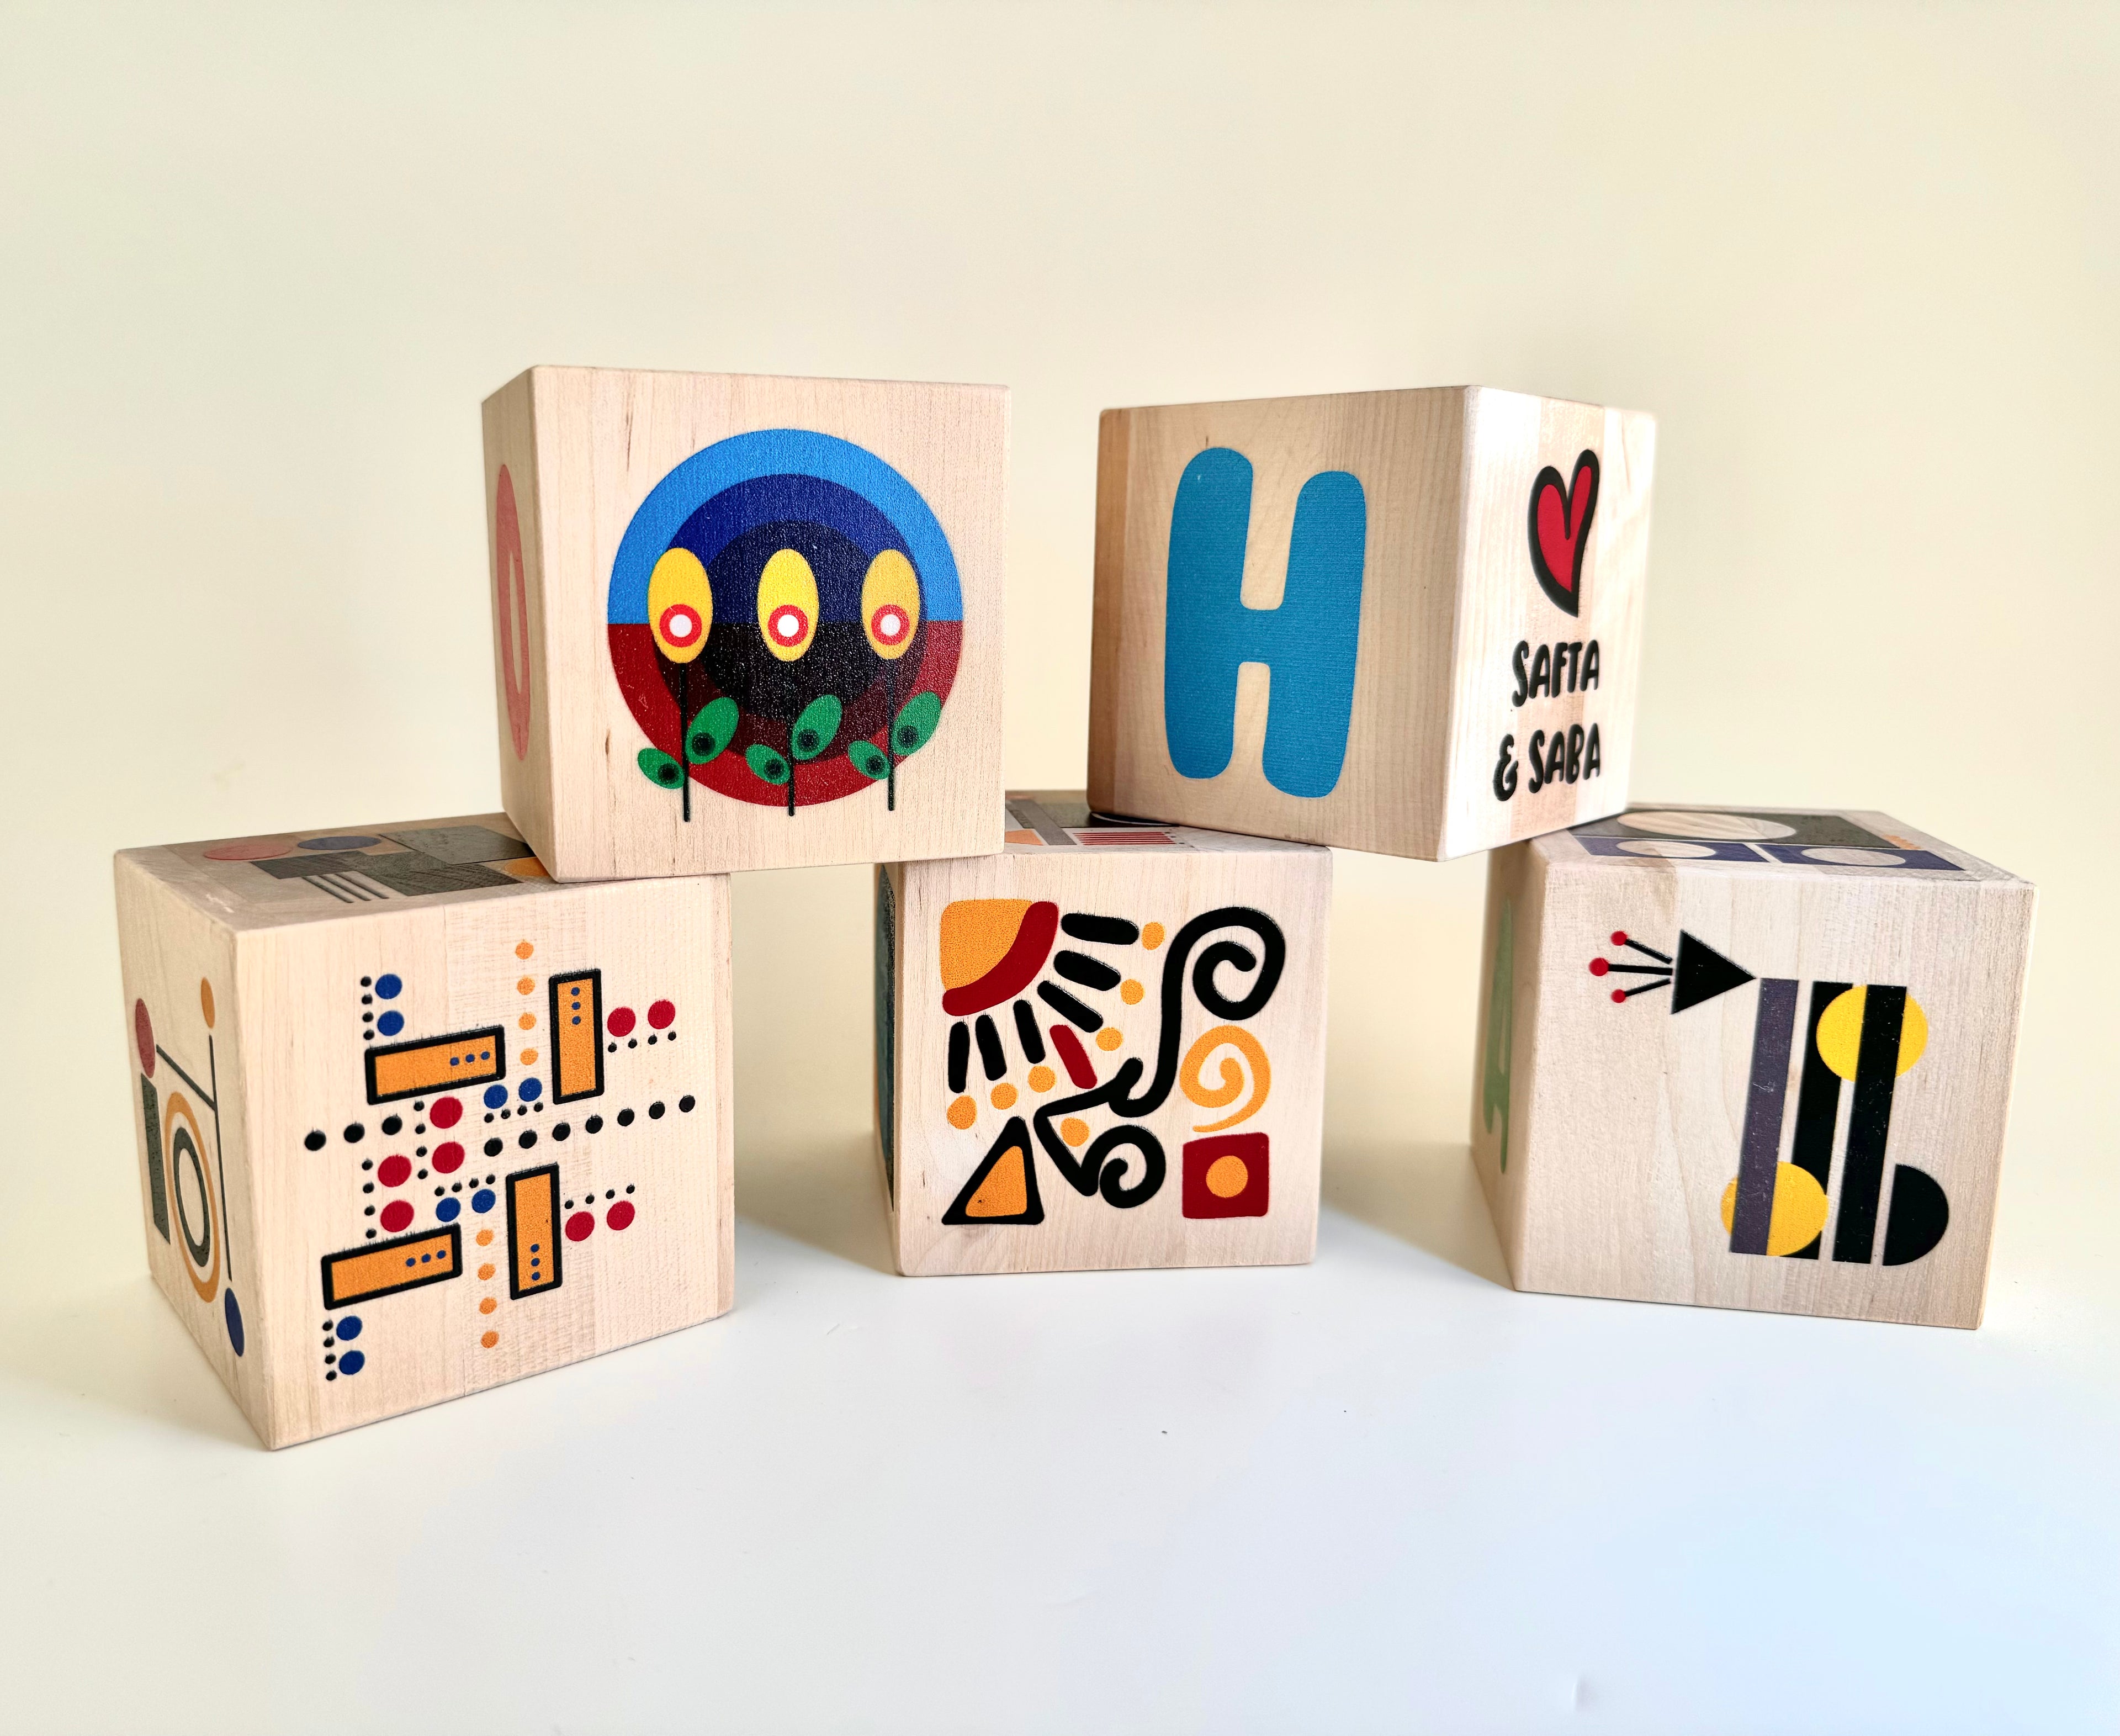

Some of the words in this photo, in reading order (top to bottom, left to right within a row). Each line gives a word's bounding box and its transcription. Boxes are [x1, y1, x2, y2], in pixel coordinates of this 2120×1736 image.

[1164, 447, 1367, 798] H
[1512, 639, 1599, 707] SAFTA
[1493, 734, 1519, 802] &
[1528, 723, 1600, 793] SABA
